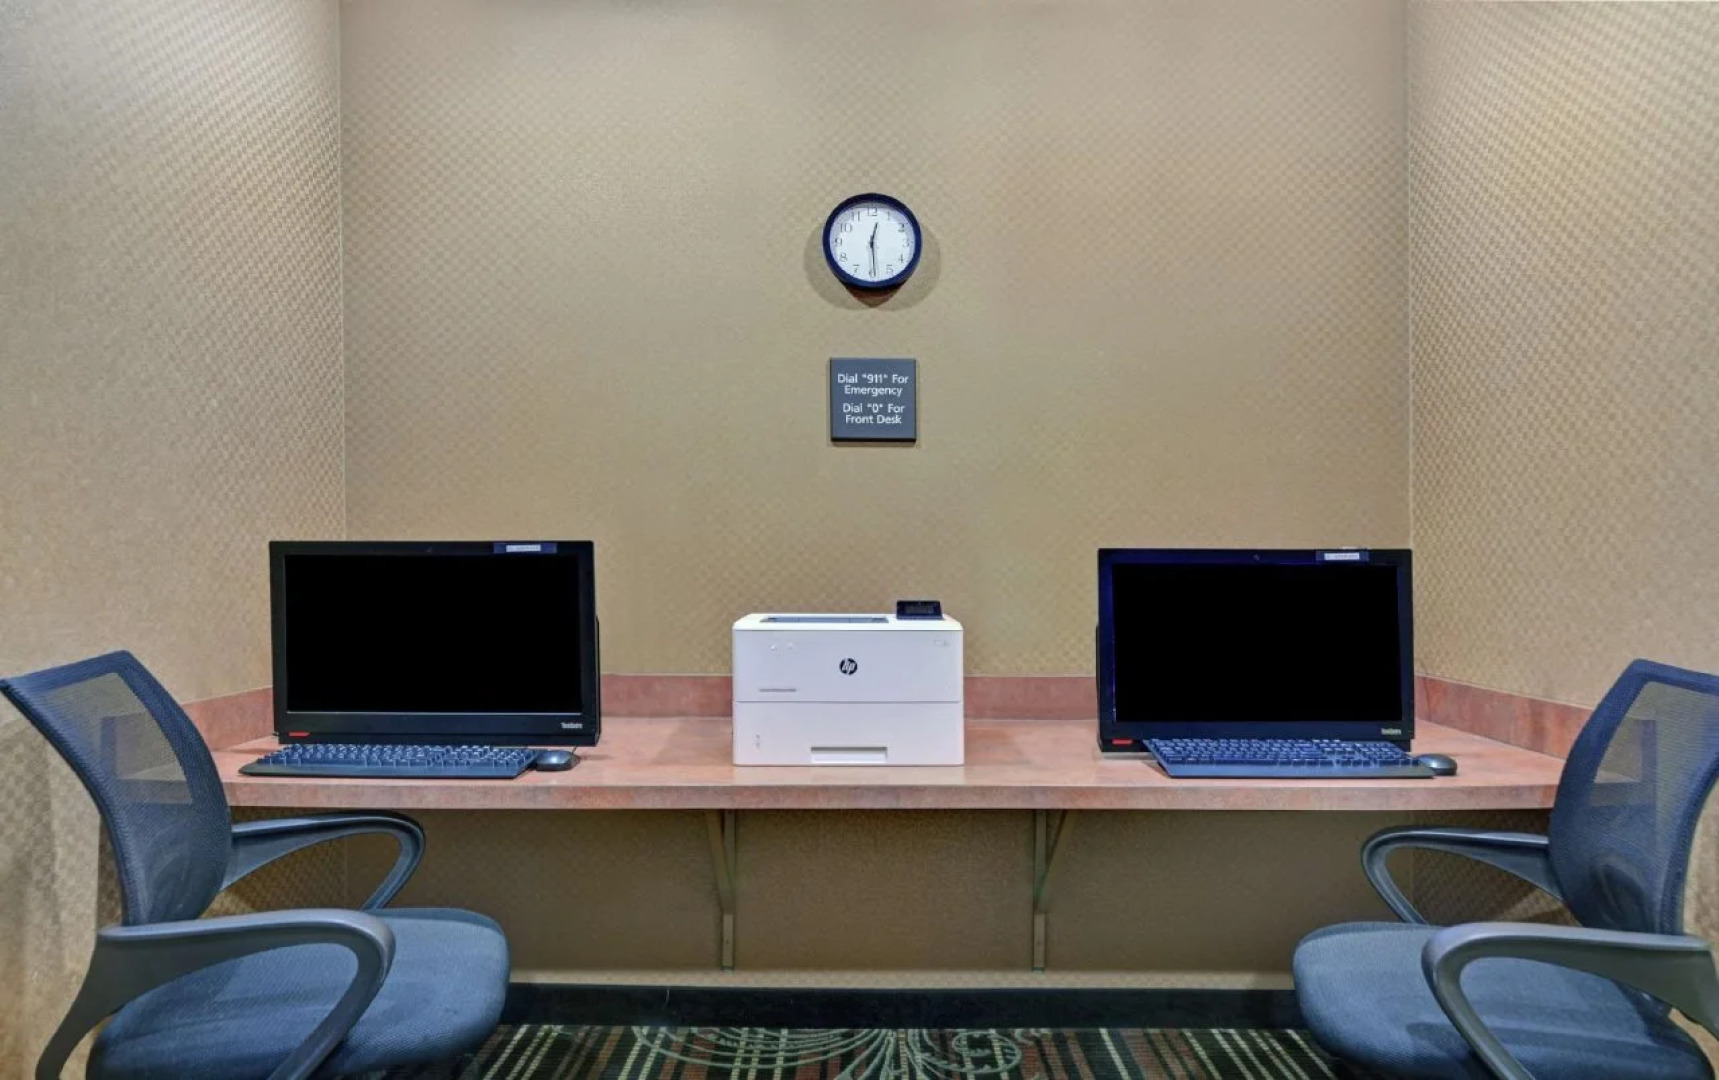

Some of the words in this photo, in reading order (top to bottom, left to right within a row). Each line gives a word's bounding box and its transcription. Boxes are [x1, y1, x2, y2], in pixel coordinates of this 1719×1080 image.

[851, 211, 860, 222] 11
[867, 207, 878, 216] 12
[840, 222, 853, 233] 10
[898, 222, 905, 233] 2
[834, 237, 843, 247] 9
[902, 238, 910, 248] 3
[840, 252, 848, 262] 8
[897, 253, 905, 263] 4
[852, 264, 860, 273] 7
[885, 264, 894, 274] 5
[837, 373, 858, 384] Dial
[861, 373, 888, 384] "911"
[892, 373, 909, 384] For
[844, 385, 904, 397] Emergency
[842, 402, 863, 413] Dial
[866, 402, 884, 413] "0"
[887, 403, 906, 413] For
[845, 414, 874, 424] Front
[876, 414, 902, 424] Desk
[839, 658, 858, 675] hp
